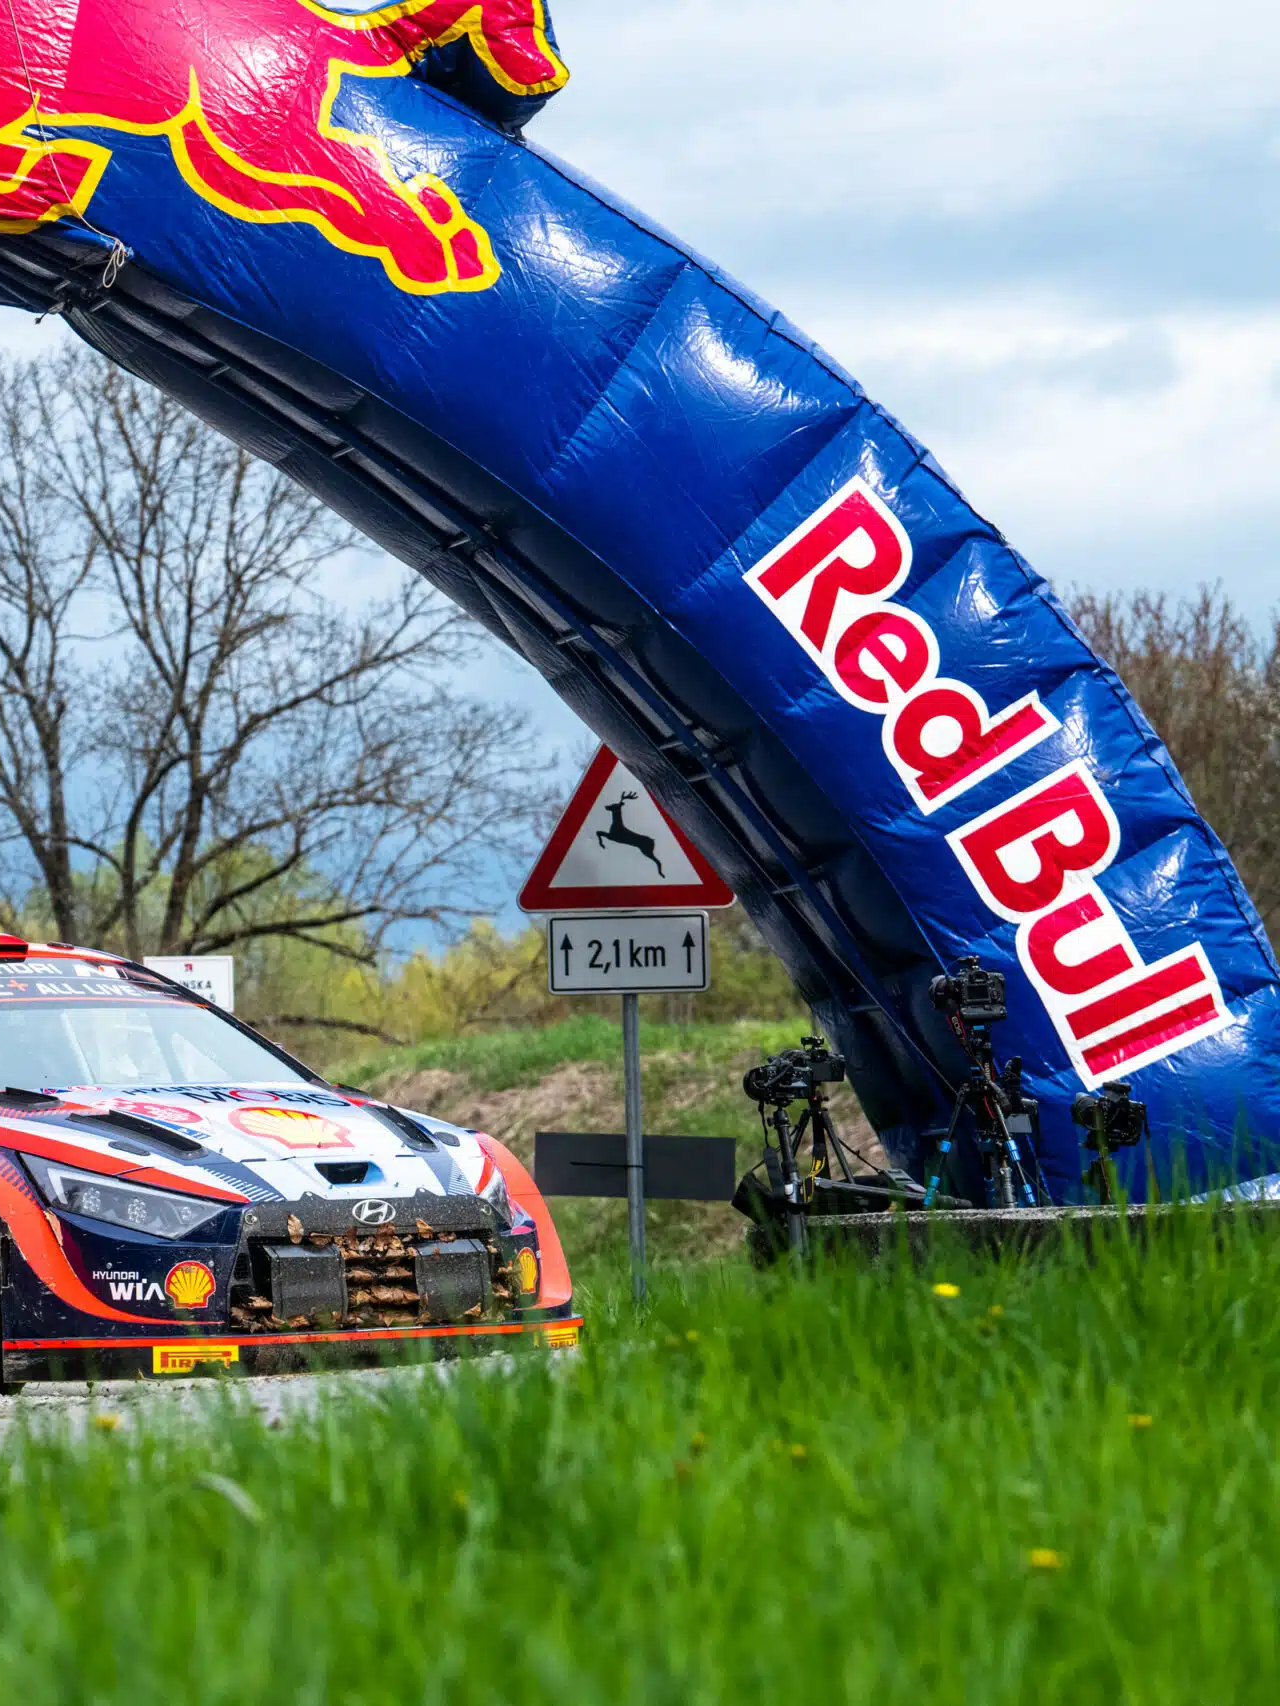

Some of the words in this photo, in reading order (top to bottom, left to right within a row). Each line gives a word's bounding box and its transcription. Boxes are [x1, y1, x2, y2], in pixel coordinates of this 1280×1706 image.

[743, 475, 1062, 816] Red
[946, 758, 1235, 1091] Bull
[587, 939, 621, 974] 2,1
[629, 939, 666, 968] km
[36, 983, 84, 995] ALL
[82, 983, 143, 997] LIVE
[180, 1090, 352, 1107] MOBIS
[92, 1271, 139, 1280] HYUNDAI
[109, 1278, 166, 1301] WIA
